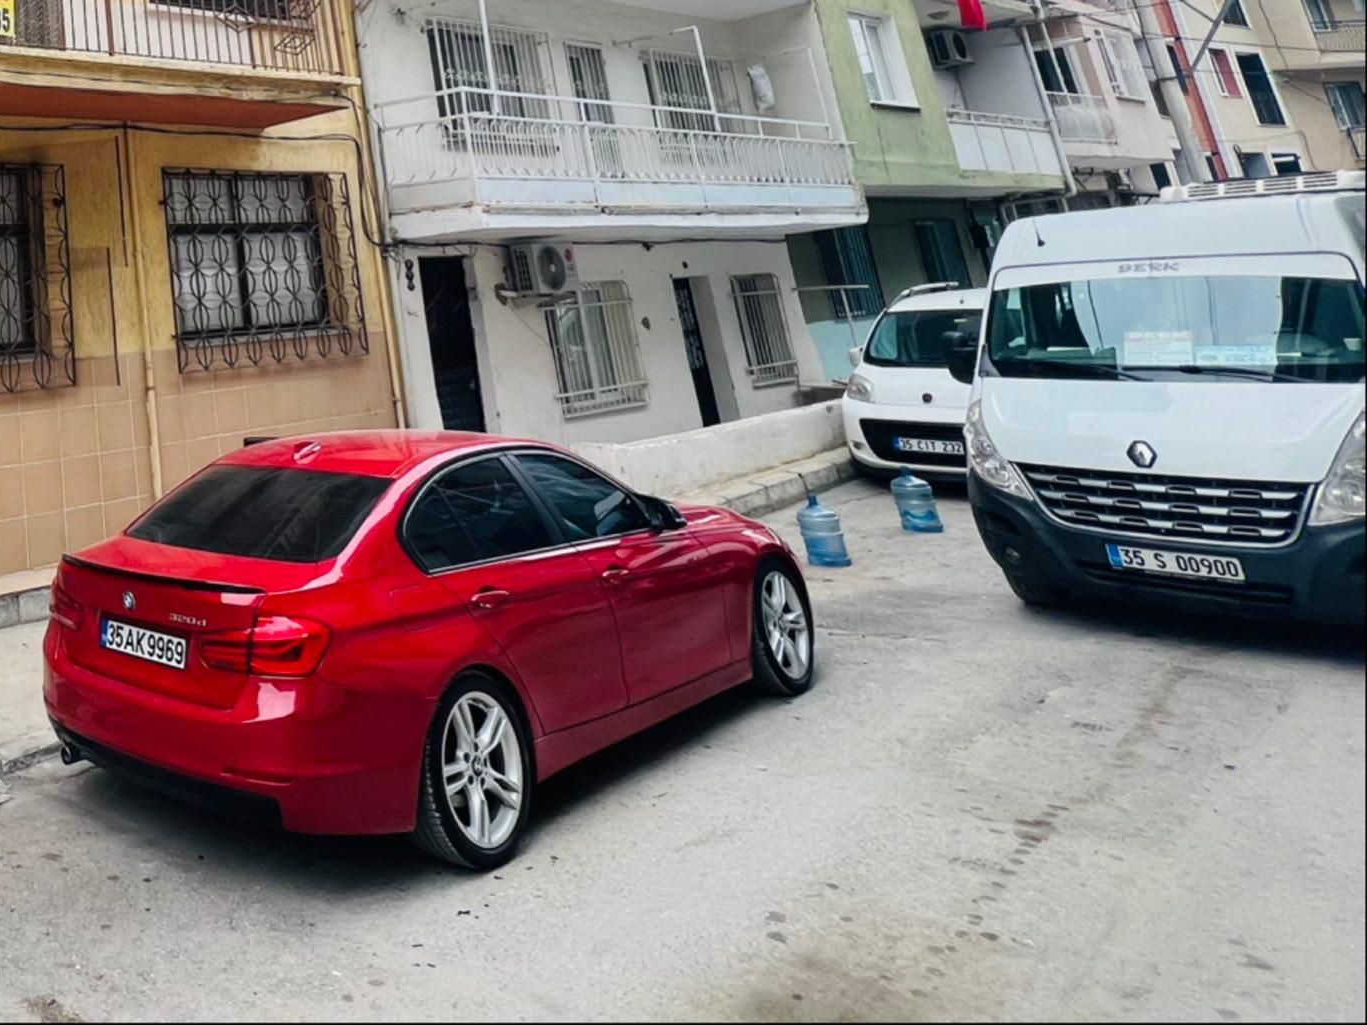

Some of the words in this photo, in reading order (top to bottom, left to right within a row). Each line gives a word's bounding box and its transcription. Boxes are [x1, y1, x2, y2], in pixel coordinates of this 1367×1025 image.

[1120, 548, 1145, 566] 35
[1153, 552, 1167, 569] S
[1175, 555, 1239, 578] 00900
